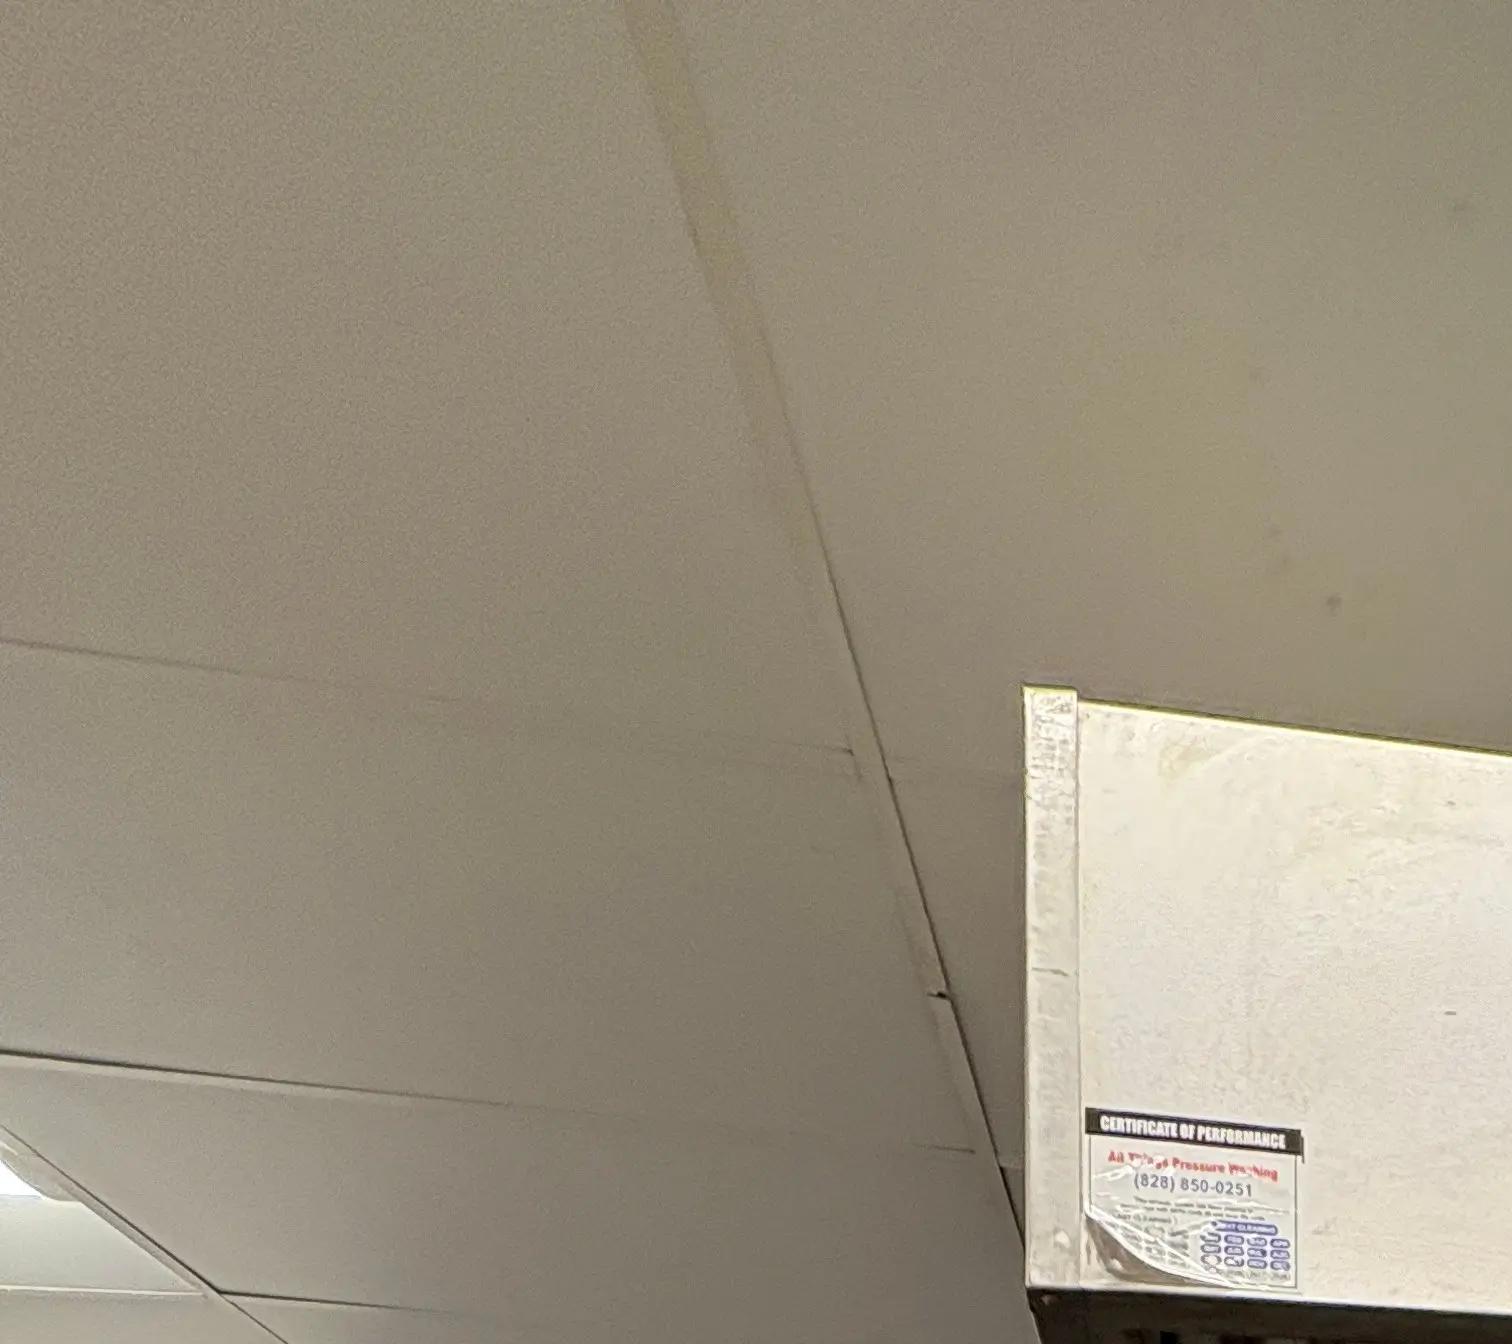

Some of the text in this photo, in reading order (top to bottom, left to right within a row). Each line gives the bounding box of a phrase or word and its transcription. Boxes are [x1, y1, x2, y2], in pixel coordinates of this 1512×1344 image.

[1100, 1115, 1286, 1150] CERTIFICATE OF PERFORMANCE
[1172, 1158, 1225, 1174] Pressure
[1134, 1174, 1252, 1197] (828) 850-0251
